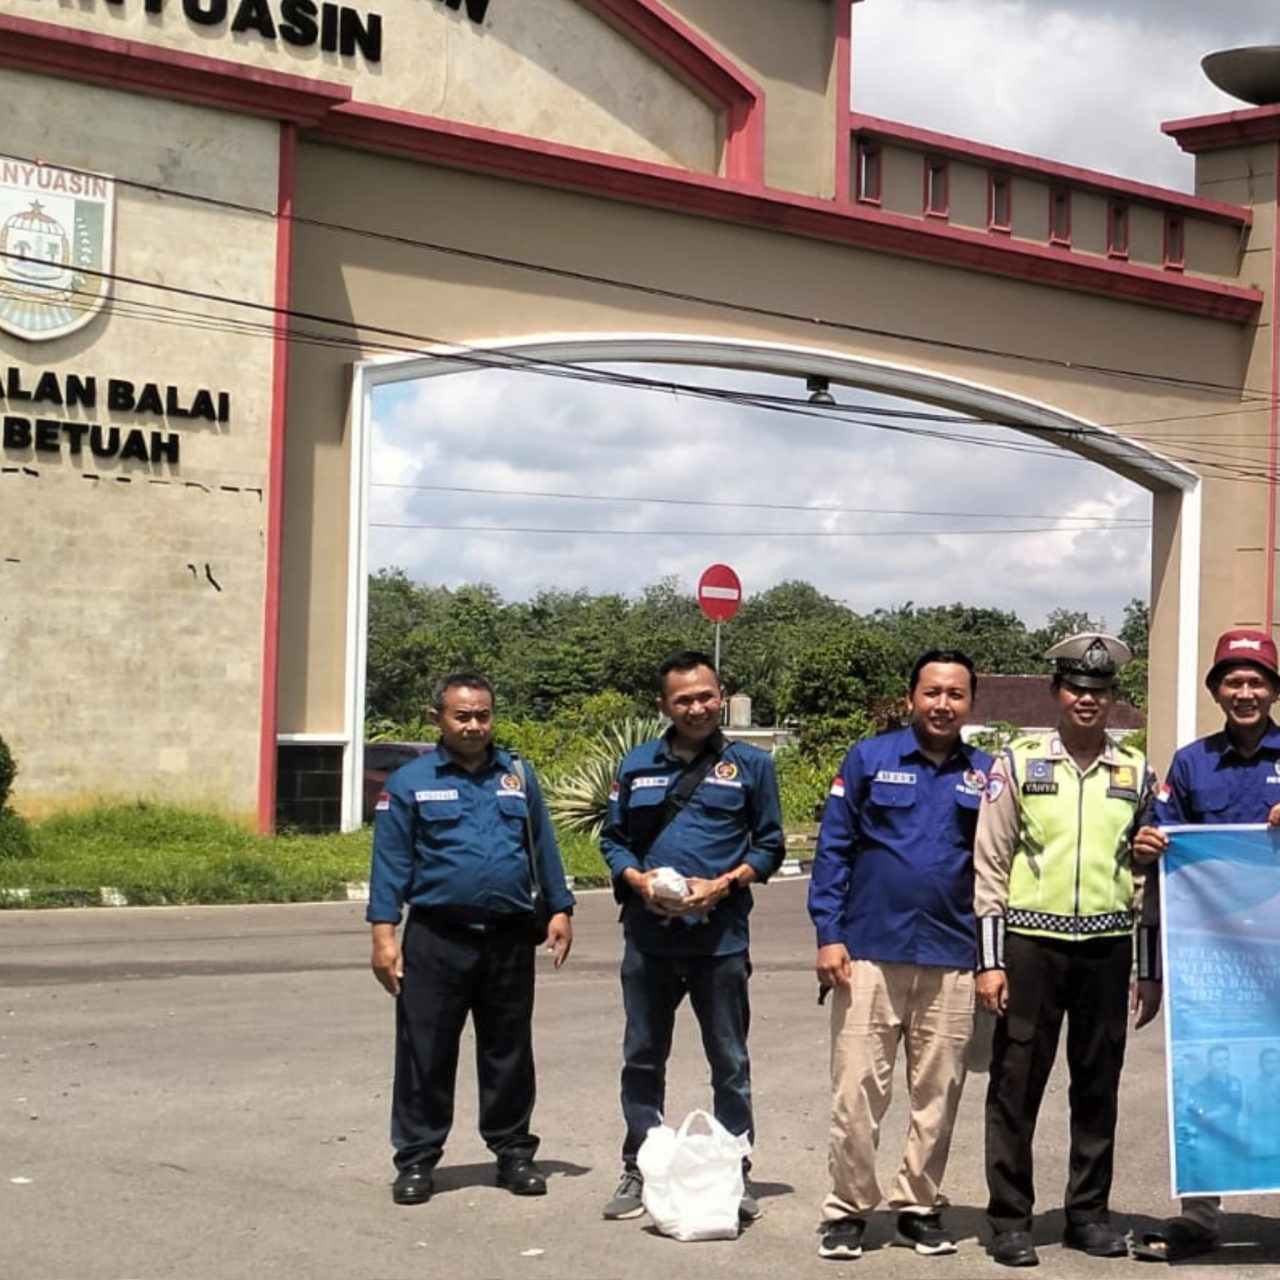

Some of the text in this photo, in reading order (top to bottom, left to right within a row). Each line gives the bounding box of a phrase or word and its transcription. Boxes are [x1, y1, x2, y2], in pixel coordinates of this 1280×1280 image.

[0, 366, 229, 422] LAN BALAI
[3, 415, 180, 464] BETUAH
